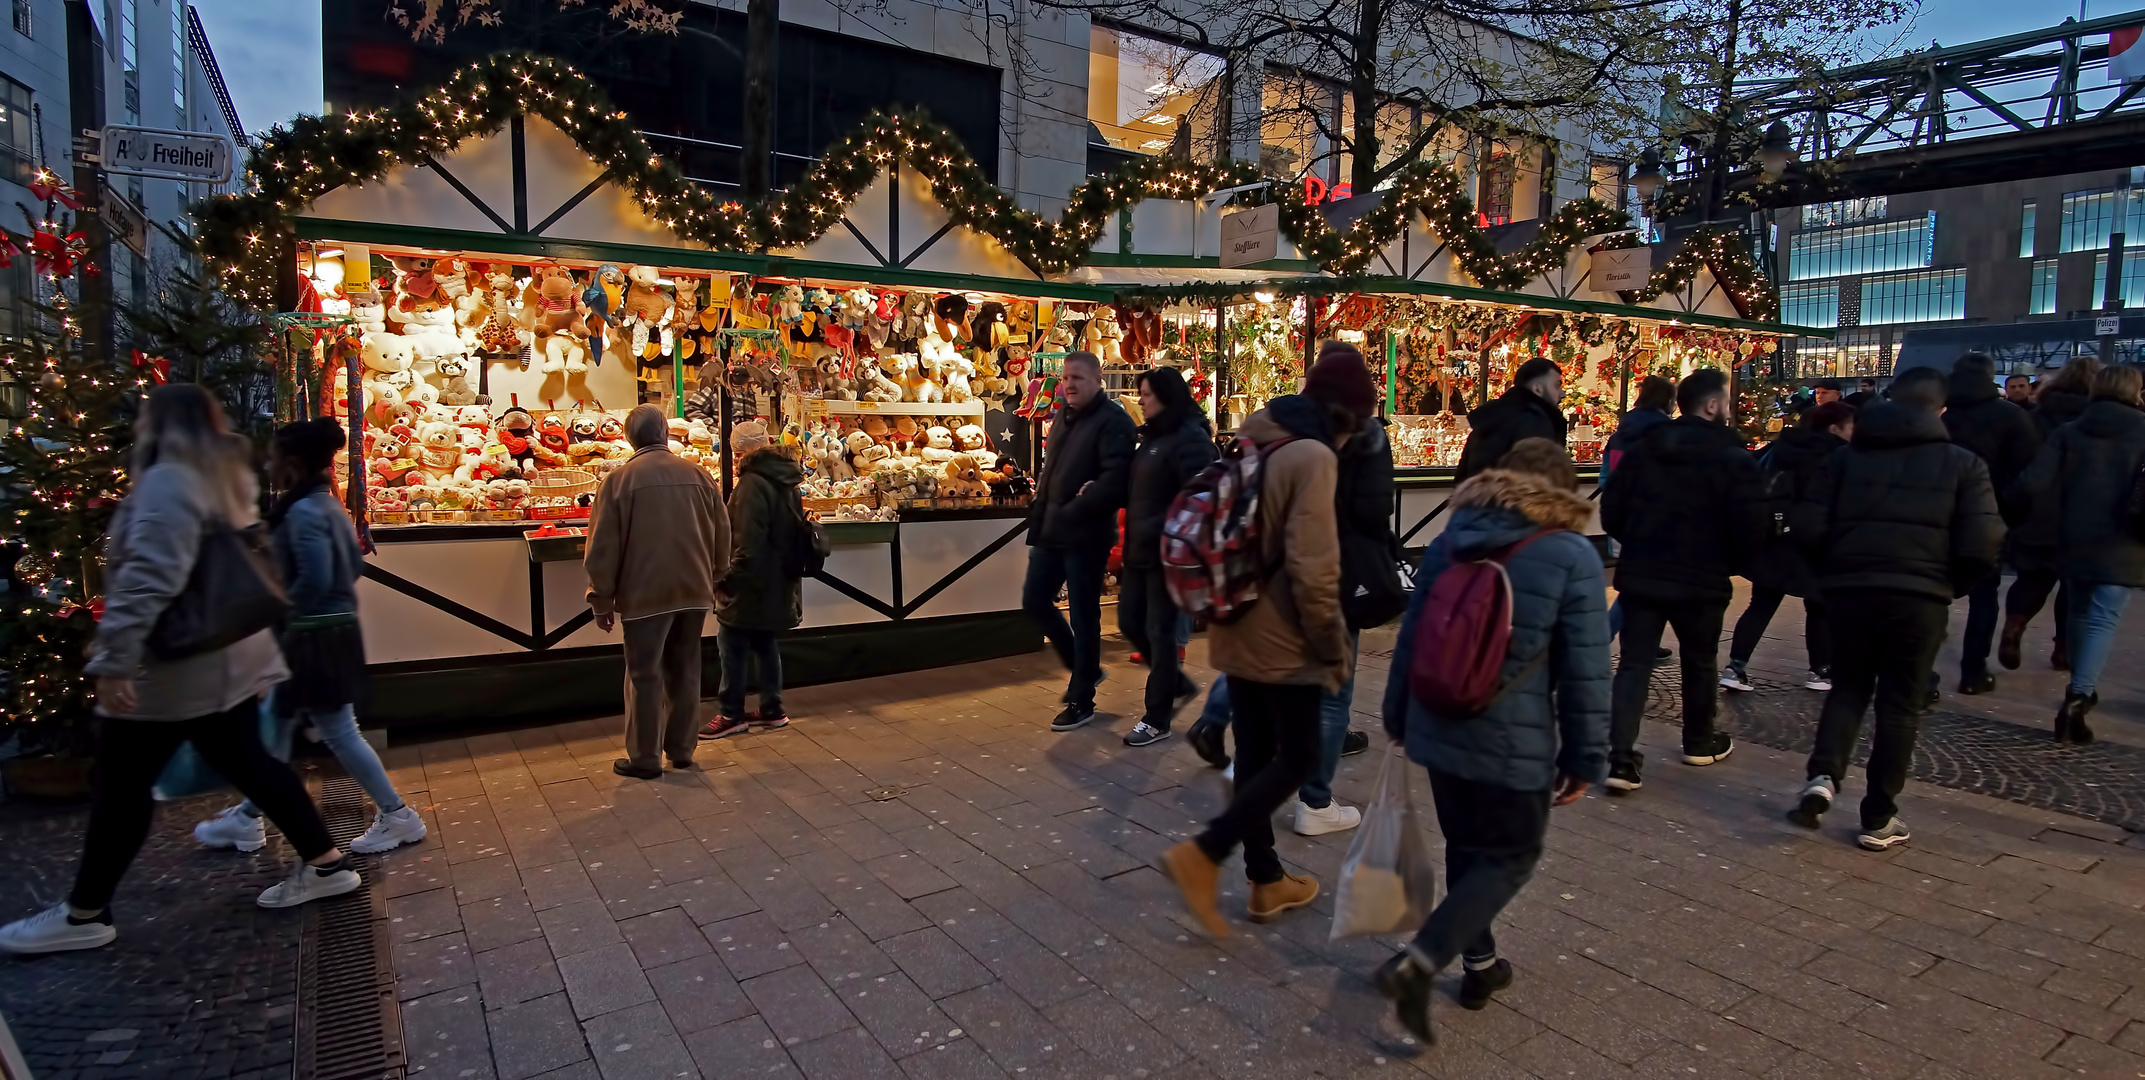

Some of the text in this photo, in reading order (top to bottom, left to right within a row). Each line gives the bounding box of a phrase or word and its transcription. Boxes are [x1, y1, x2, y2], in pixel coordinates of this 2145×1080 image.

[153, 143, 214, 169] Freiheit
[1926, 215, 1936, 261] PRIMARK
[2097, 318, 2118, 328] Polizei
